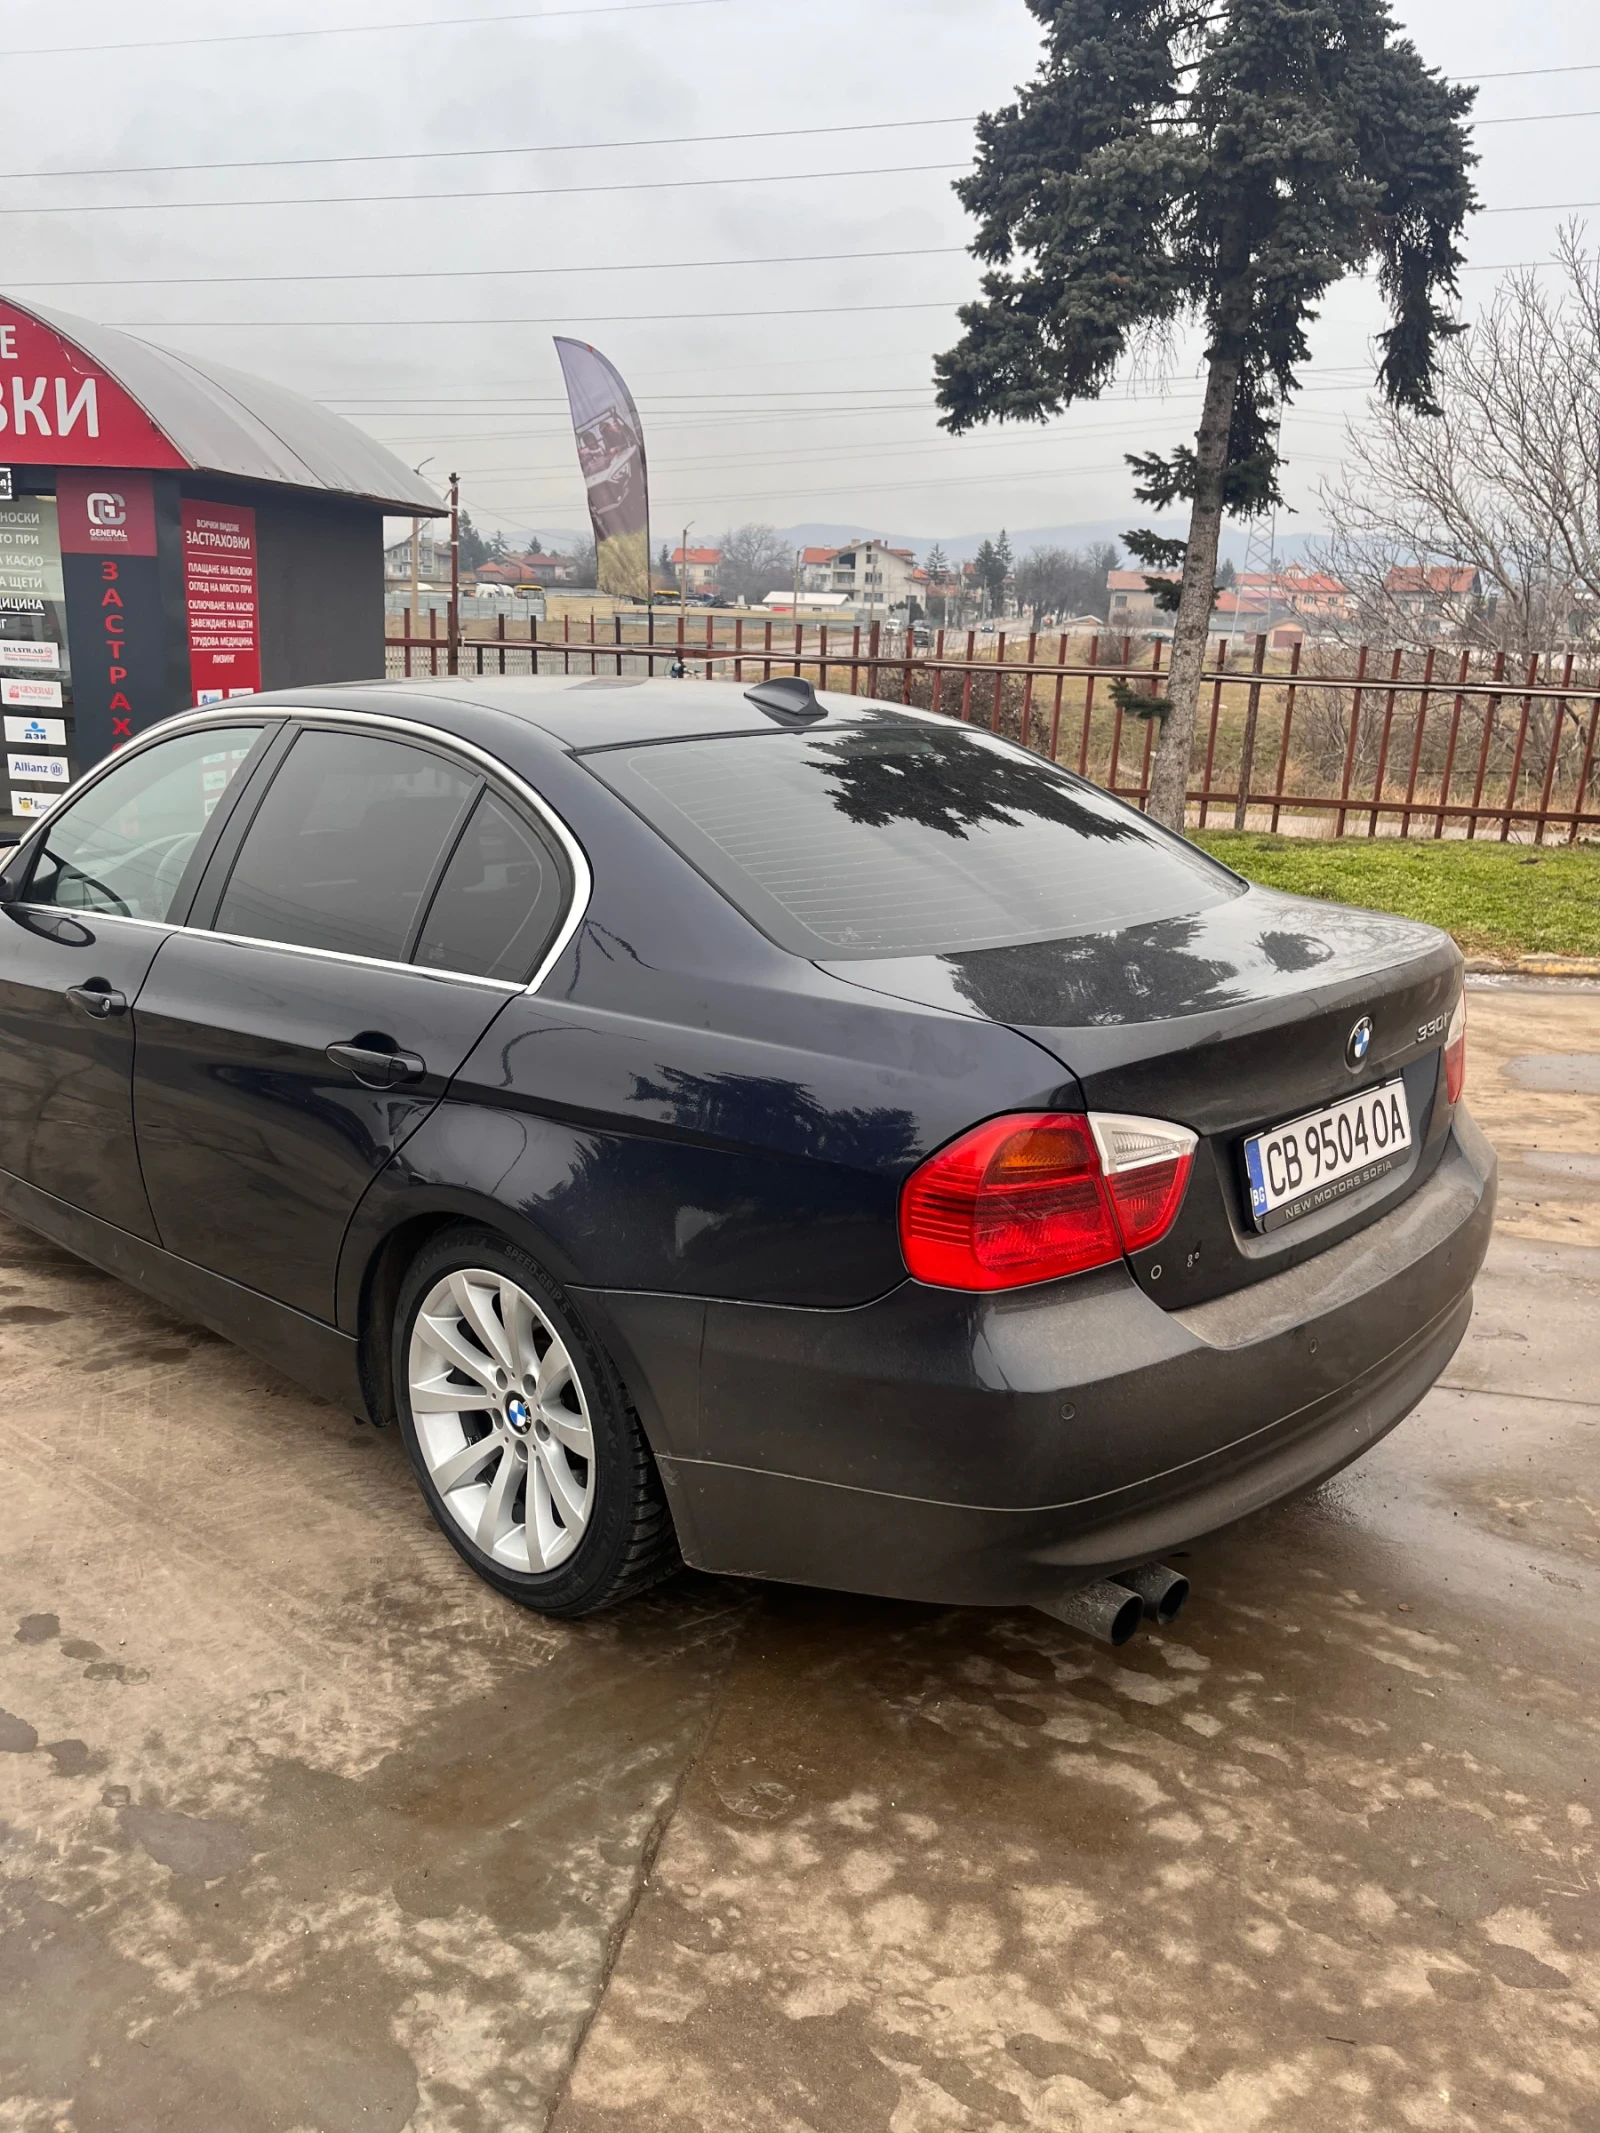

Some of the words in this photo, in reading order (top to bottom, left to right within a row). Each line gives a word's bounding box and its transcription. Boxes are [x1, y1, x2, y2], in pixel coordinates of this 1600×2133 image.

[0, 376, 99, 438] КИ
[197, 519, 219, 530] ВСИЧКИ
[219, 521, 240, 532] ВИДОВЕ
[15, 534, 39, 545] ПРИ
[90, 528, 128, 538] GENERAL
[186, 530, 251, 549] ЗАСТРАХОВКИ
[6, 554, 44, 567] КАСКО
[188, 562, 220, 575] ПЛАЩАНЕ
[220, 565, 229, 575] НА
[229, 566, 253, 577] ВНОСКИ
[9, 576, 43, 590] ЩЕТИ
[188, 581, 210, 593] ОГЛЕД
[210, 582, 219, 592] НА
[219, 583, 240, 593] МЯСТО
[240, 584, 253, 594] ПРИ
[188, 599, 226, 611] СКЛЮЧВАНЕ
[226, 601, 235, 611] НА
[235, 602, 254, 611] КАСКО
[190, 618, 227, 629] ЗАВЕЖДАНЕ
[227, 619, 236, 629] НА
[236, 619, 254, 630] ЩЕТИ
[191, 636, 219, 647] ТРУДОВА
[219, 637, 254, 647] МЕДИЦИНА
[3, 646, 44, 654] BULSTRAD
[212, 654, 236, 664] ЛИЗИНГ
[19, 685, 54, 696] GENERALI
[14, 761, 48, 774] Allianz
[1305, 1106, 1369, 1179] 9504
[1252, 1186, 1266, 1206] BG
[1284, 1198, 1312, 1219] NEW
[1314, 1175, 1361, 1204] MOTORS
[1363, 1160, 1393, 1182] SOFIA
[503, 1245, 562, 1301] SPEED-GRIP
[559, 1302, 571, 1314] 5
